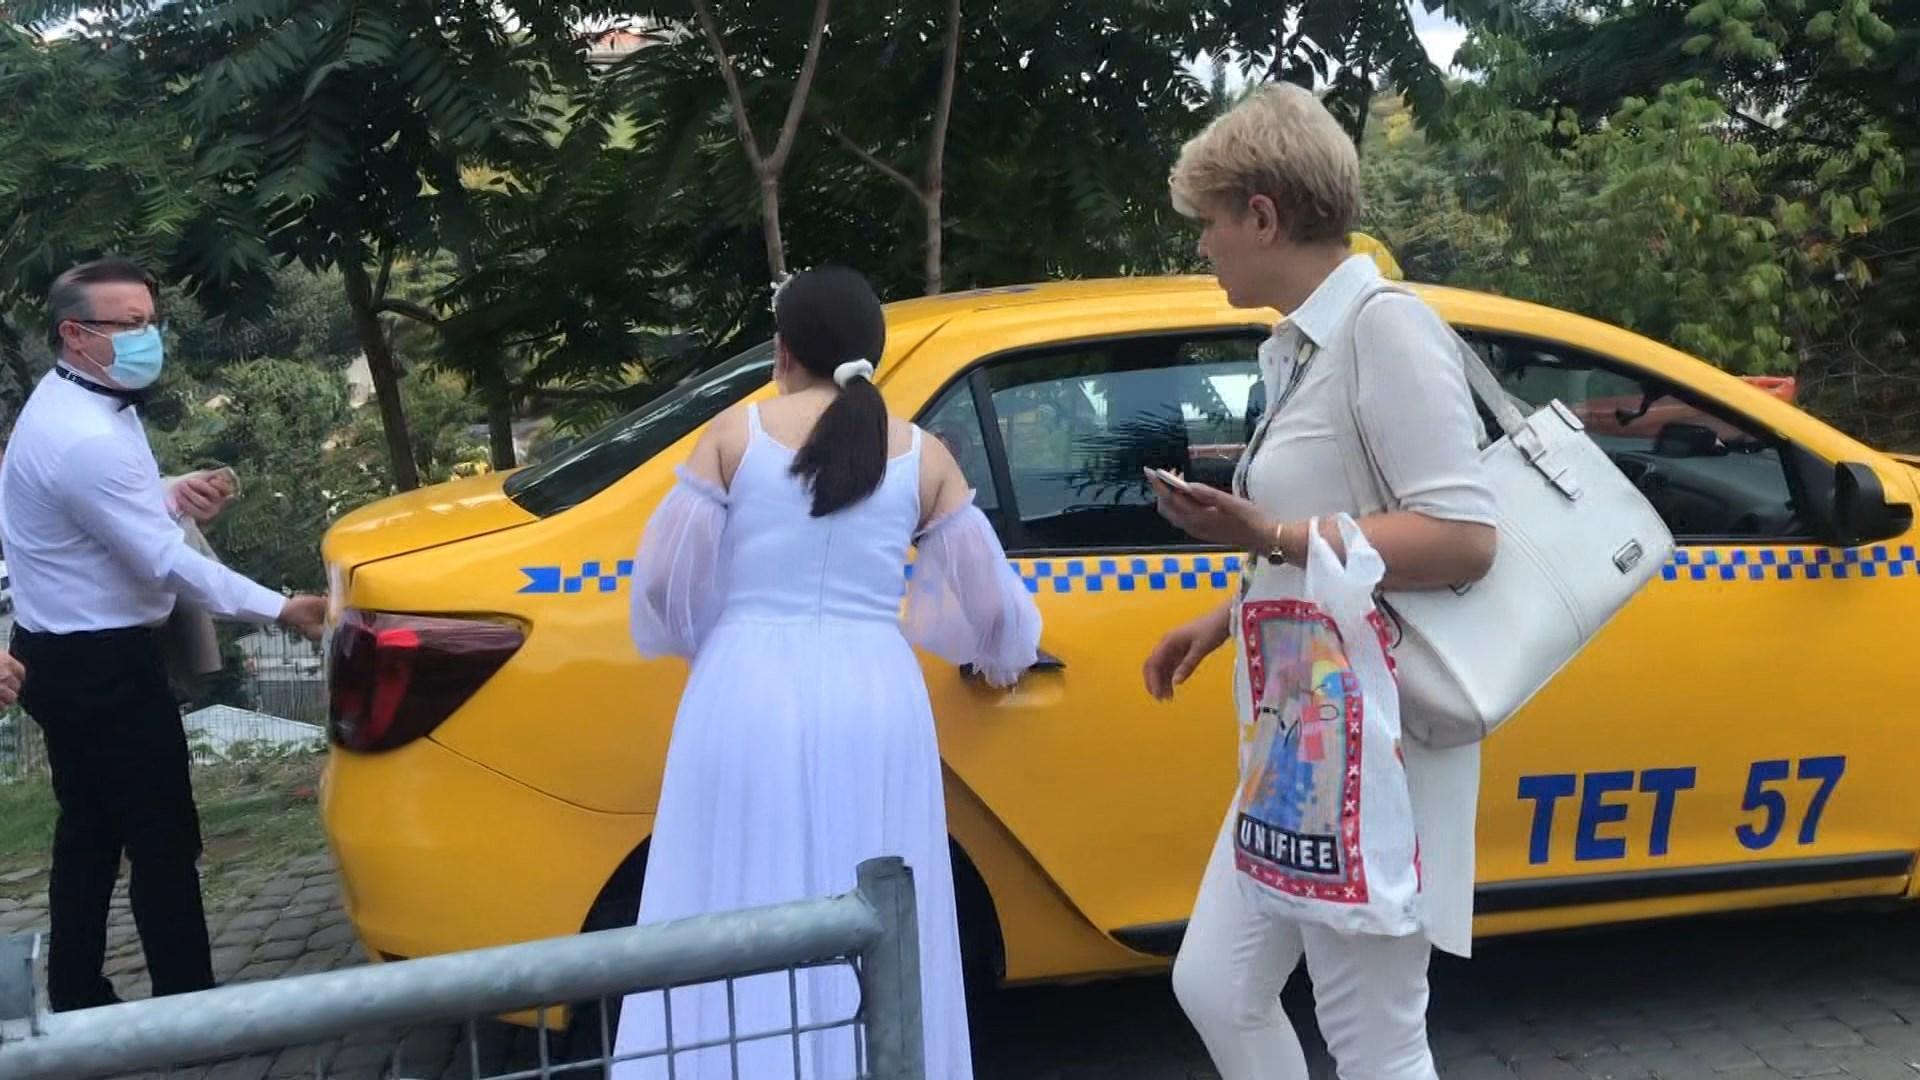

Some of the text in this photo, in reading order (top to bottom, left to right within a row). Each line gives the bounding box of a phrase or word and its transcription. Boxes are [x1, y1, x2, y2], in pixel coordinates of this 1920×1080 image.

[1240, 819, 1334, 870] UNIFIEE
[1517, 755, 1846, 865] TET 57
